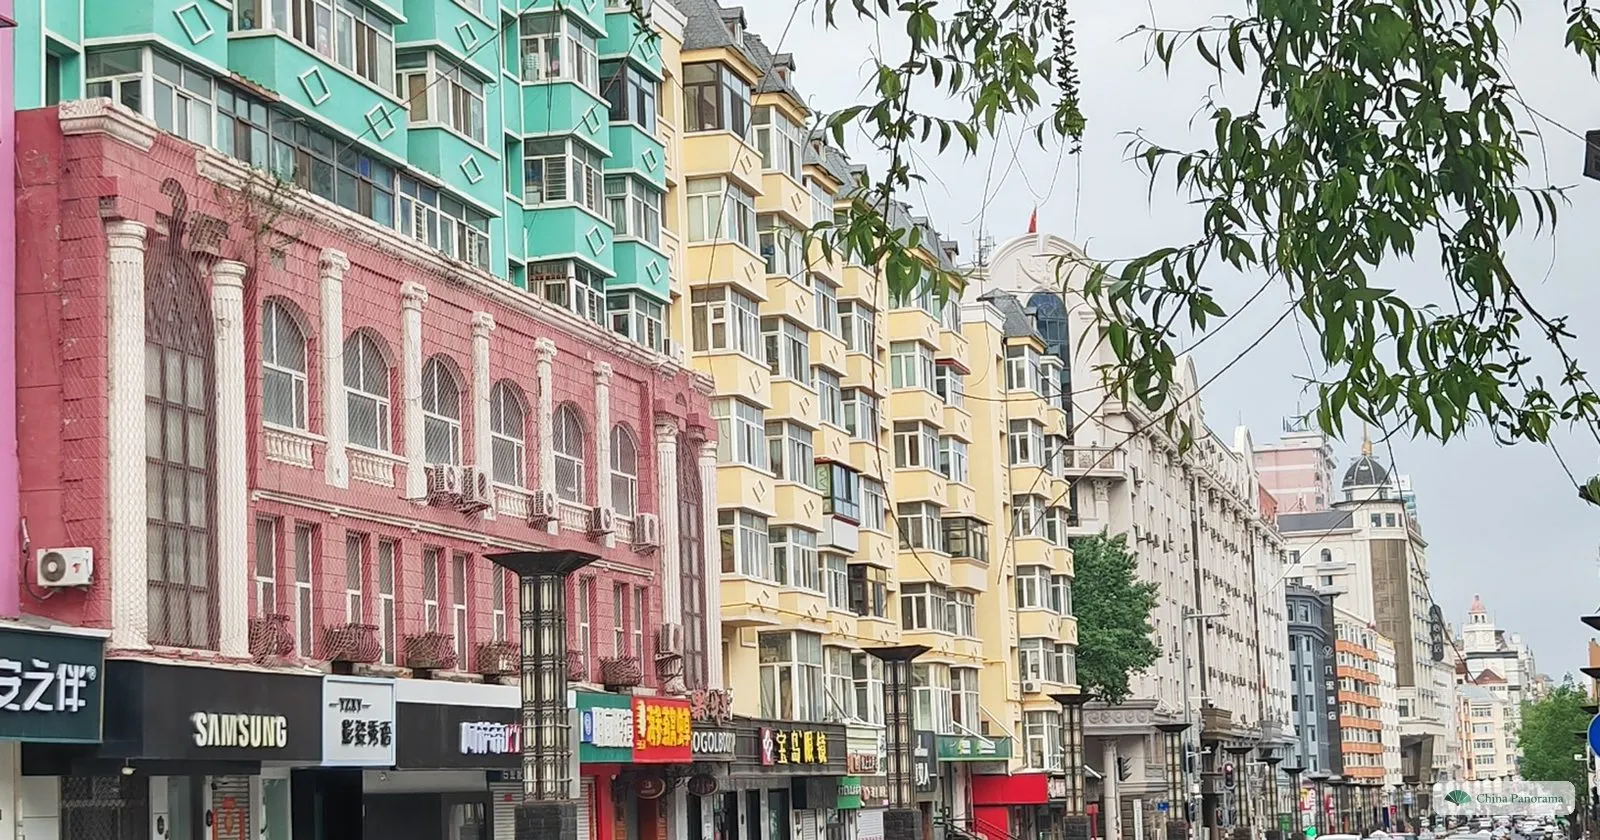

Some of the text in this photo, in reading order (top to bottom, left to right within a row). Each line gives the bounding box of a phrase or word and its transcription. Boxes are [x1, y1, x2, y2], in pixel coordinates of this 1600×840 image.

[191, 711, 288, 748] SAMSUNG
[776, 729, 828, 765] 宝岛眼镜
